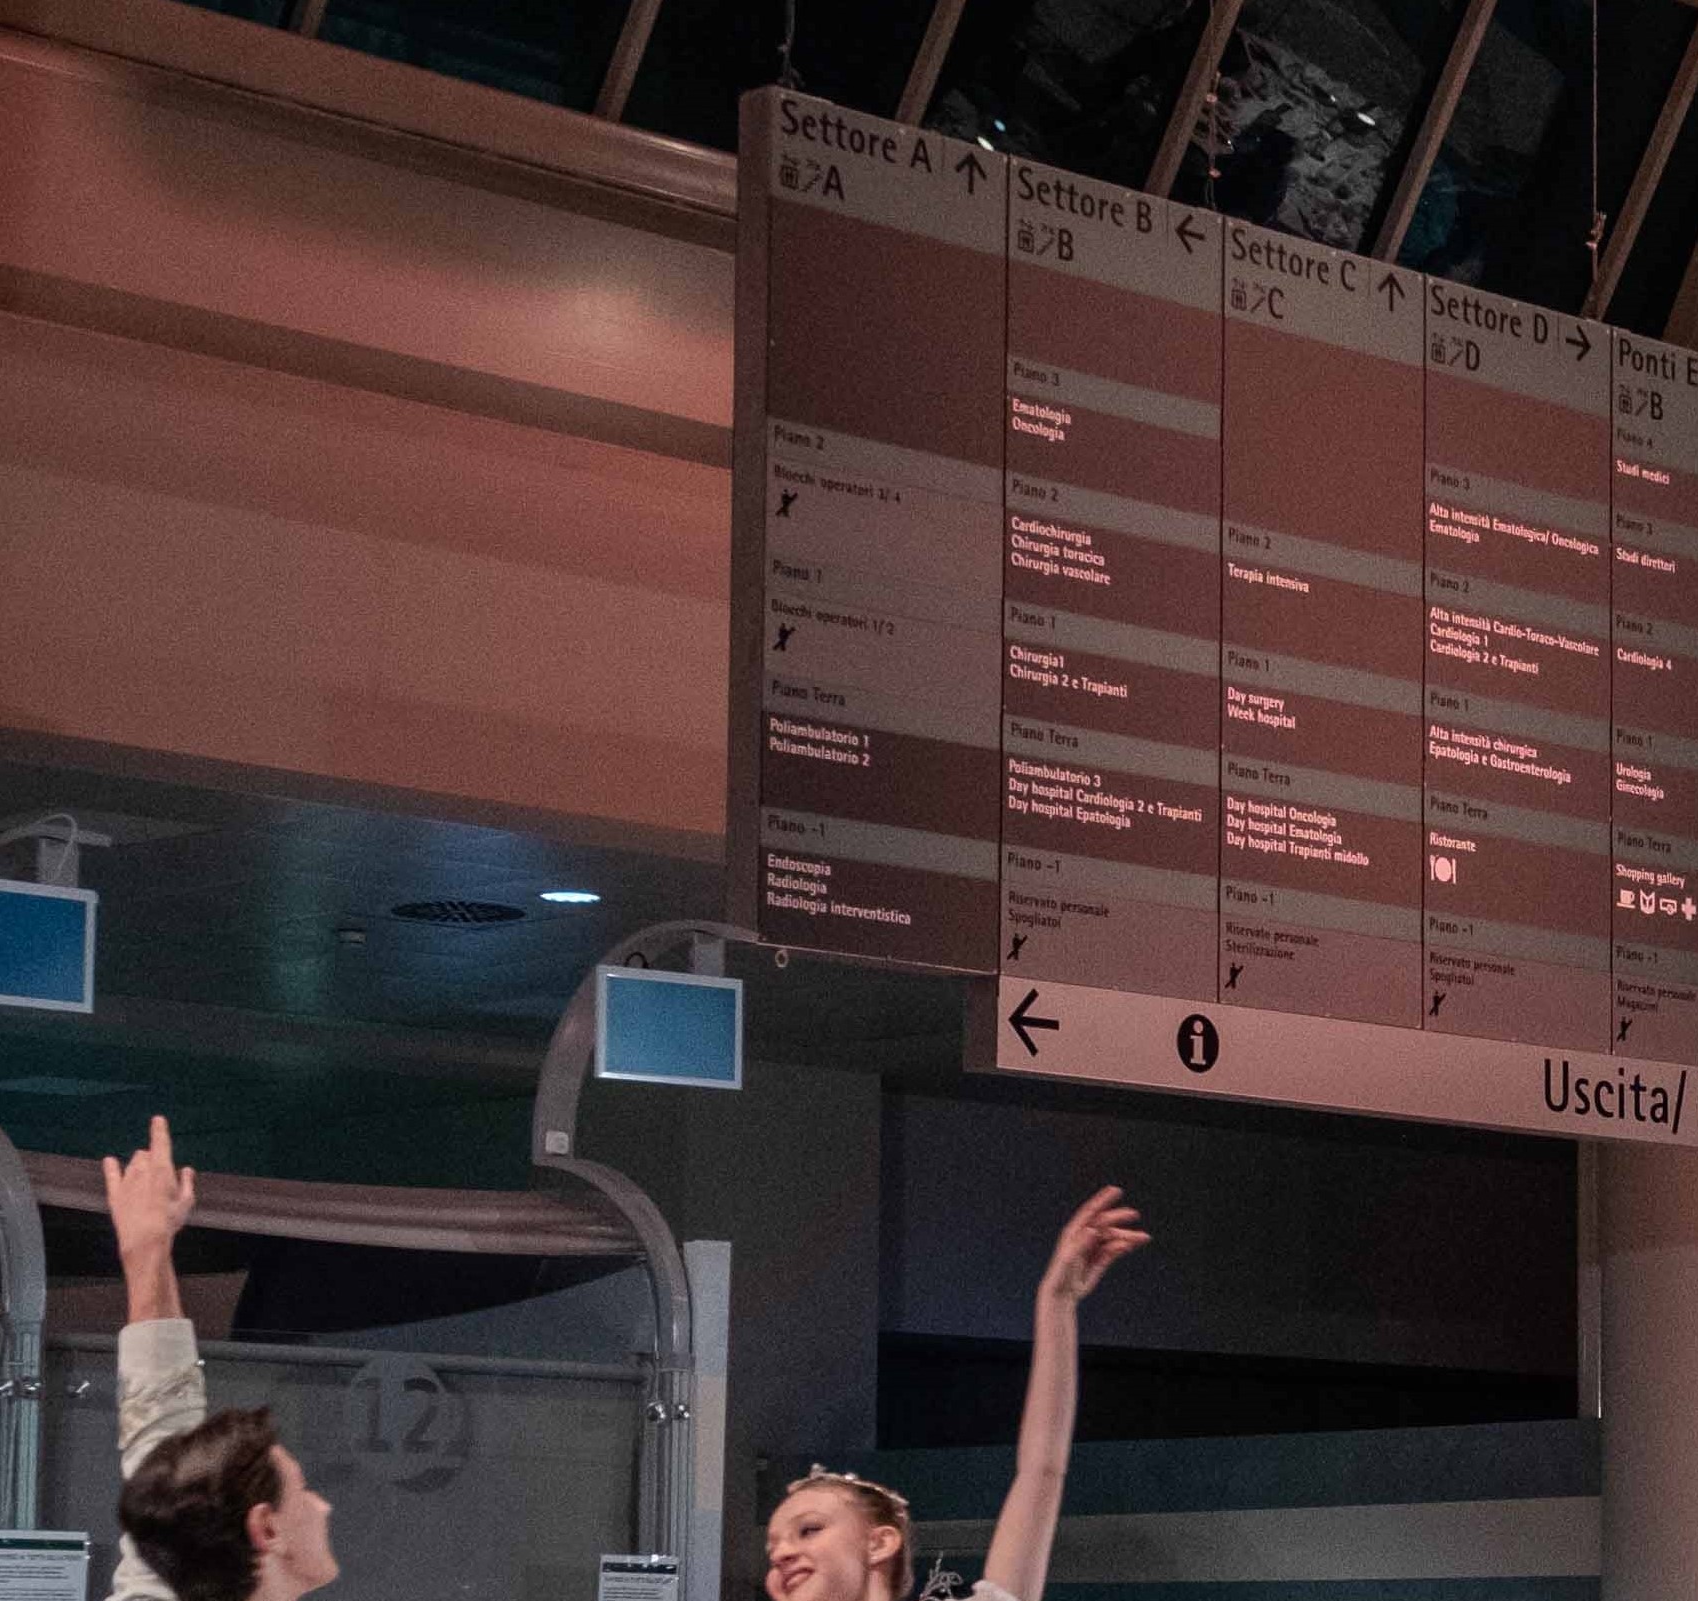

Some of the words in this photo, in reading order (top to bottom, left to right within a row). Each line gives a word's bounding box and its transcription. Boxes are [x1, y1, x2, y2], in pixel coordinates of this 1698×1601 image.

[779, 99, 897, 164] Settore
[910, 138, 933, 174] A
[822, 164, 845, 200] A
[1017, 166, 1125, 228] Settore
[1137, 202, 1153, 234] B
[1058, 228, 1075, 261] B
[1231, 228, 1329, 286] Settore
[1341, 259, 1357, 292] C
[1268, 287, 1285, 320] C
[1430, 286, 1523, 339] Settore
[1533, 313, 1549, 344] D
[1465, 340, 1481, 371] D
[1618, 338, 1676, 381] Ponti
[1013, 362, 1049, 386] Piano
[1052, 372, 1061, 388] 3
[1012, 399, 1072, 426] Ematologia
[1651, 392, 1664, 421] B
[1012, 416, 1065, 442] Oncologia
[1430, 467, 1461, 490] Piano
[1463, 475, 1471, 491] 3
[1616, 459, 1640, 479] Studi
[1641, 467, 1670, 486] medici
[1012, 478, 1047, 501] Piano
[1050, 486, 1060, 502] 2
[1011, 516, 1093, 548] Cardiochirurgia
[1228, 526, 1260, 548] Piano
[1264, 536, 1272, 550] 2
[1429, 503, 1450, 520] Alta
[1451, 507, 1490, 529] intensità
[1552, 532, 1599, 556] Oncologica
[1429, 519, 1480, 543] Ematologia
[1011, 534, 1061, 560] Chirurgia
[1063, 544, 1106, 568] toracica
[1616, 547, 1640, 566] Studi
[1641, 553, 1676, 574] direttori
[1011, 551, 1061, 577] Chirurgia
[1063, 564, 1112, 587] vascolare
[1227, 562, 1264, 585] Terapia
[1266, 569, 1310, 594] intensiva
[1430, 572, 1460, 592] Piano
[1461, 580, 1470, 593] 2
[1430, 607, 1450, 623] Alta
[1452, 611, 1491, 633] intensità
[1430, 623, 1481, 647] Cardiologia
[1483, 634, 1489, 647] 1
[1430, 640, 1481, 664] Cardiologia
[1482, 650, 1490, 665] 2
[1491, 654, 1498, 666] e
[1499, 654, 1539, 675] Trapianti
[1617, 648, 1663, 670] Cardiologia
[1665, 658, 1672, 671] 4
[771, 680, 809, 705] Piano
[813, 685, 846, 707] Terra
[1009, 663, 1060, 689] Chirurgia
[1061, 673, 1070, 688] 2
[1072, 678, 1080, 689] e
[1081, 676, 1128, 699] Trapianti
[1227, 686, 1247, 706] Day
[1248, 693, 1285, 713] surgery
[1227, 703, 1255, 722] Week
[1257, 707, 1296, 730] hospital
[769, 718, 860, 748] Poliambulatorio
[863, 734, 870, 748] 1
[1010, 721, 1045, 743] Piano
[1048, 728, 1079, 749] Terra
[1430, 725, 1449, 741] Alta
[1451, 730, 1491, 751] intensità
[1493, 737, 1537, 759] chirurgica
[769, 736, 860, 766] Poliambulatorio
[861, 752, 871, 767] 2
[1429, 741, 1480, 766] Epatologia
[1481, 755, 1488, 766] e
[1490, 754, 1571, 785] Gastroenterologia
[1009, 758, 1091, 787] Poliambulatorio
[1093, 773, 1102, 788] 3
[1227, 761, 1259, 782] Piano
[1262, 767, 1291, 787] Terra
[1616, 762, 1652, 781] Urologia
[1008, 776, 1030, 797] Day
[1032, 781, 1073, 803] hospital
[1076, 786, 1135, 813] Cardiologia
[1137, 798, 1145, 813] 2
[1147, 803, 1155, 815] e
[1157, 801, 1204, 824] Trapianti
[1616, 778, 1665, 801] Ginecologia
[1008, 795, 1030, 815] Day
[1031, 799, 1073, 821] hospital
[1076, 806, 1132, 831] Epatologia
[1227, 797, 1245, 815] Day
[1247, 801, 1287, 823] hospital
[1289, 806, 1337, 829] Oncologia
[1430, 799, 1460, 818] Piano
[1462, 804, 1488, 821] Terra
[767, 814, 805, 836] Piano
[1227, 814, 1245, 833] Day
[1247, 818, 1287, 840] hospital
[1289, 823, 1343, 848] Ematologia
[1227, 831, 1245, 851] Day
[1247, 835, 1287, 857] hospital
[1289, 840, 1332, 863] Trapianti
[1333, 849, 1370, 868] midollo
[1429, 831, 1477, 852] Ristorante
[1617, 830, 1644, 848] Piano
[1647, 835, 1672, 853] Terra
[767, 853, 832, 880] Endoscopia
[1008, 851, 1042, 873] Piano
[1616, 863, 1655, 886] Shopping
[1657, 872, 1686, 889] gallery
[767, 872, 828, 898] Radiologia
[767, 891, 827, 916] Radiologia
[830, 900, 912, 926] interventistica
[1543, 1057, 1686, 1134] Uscita/
